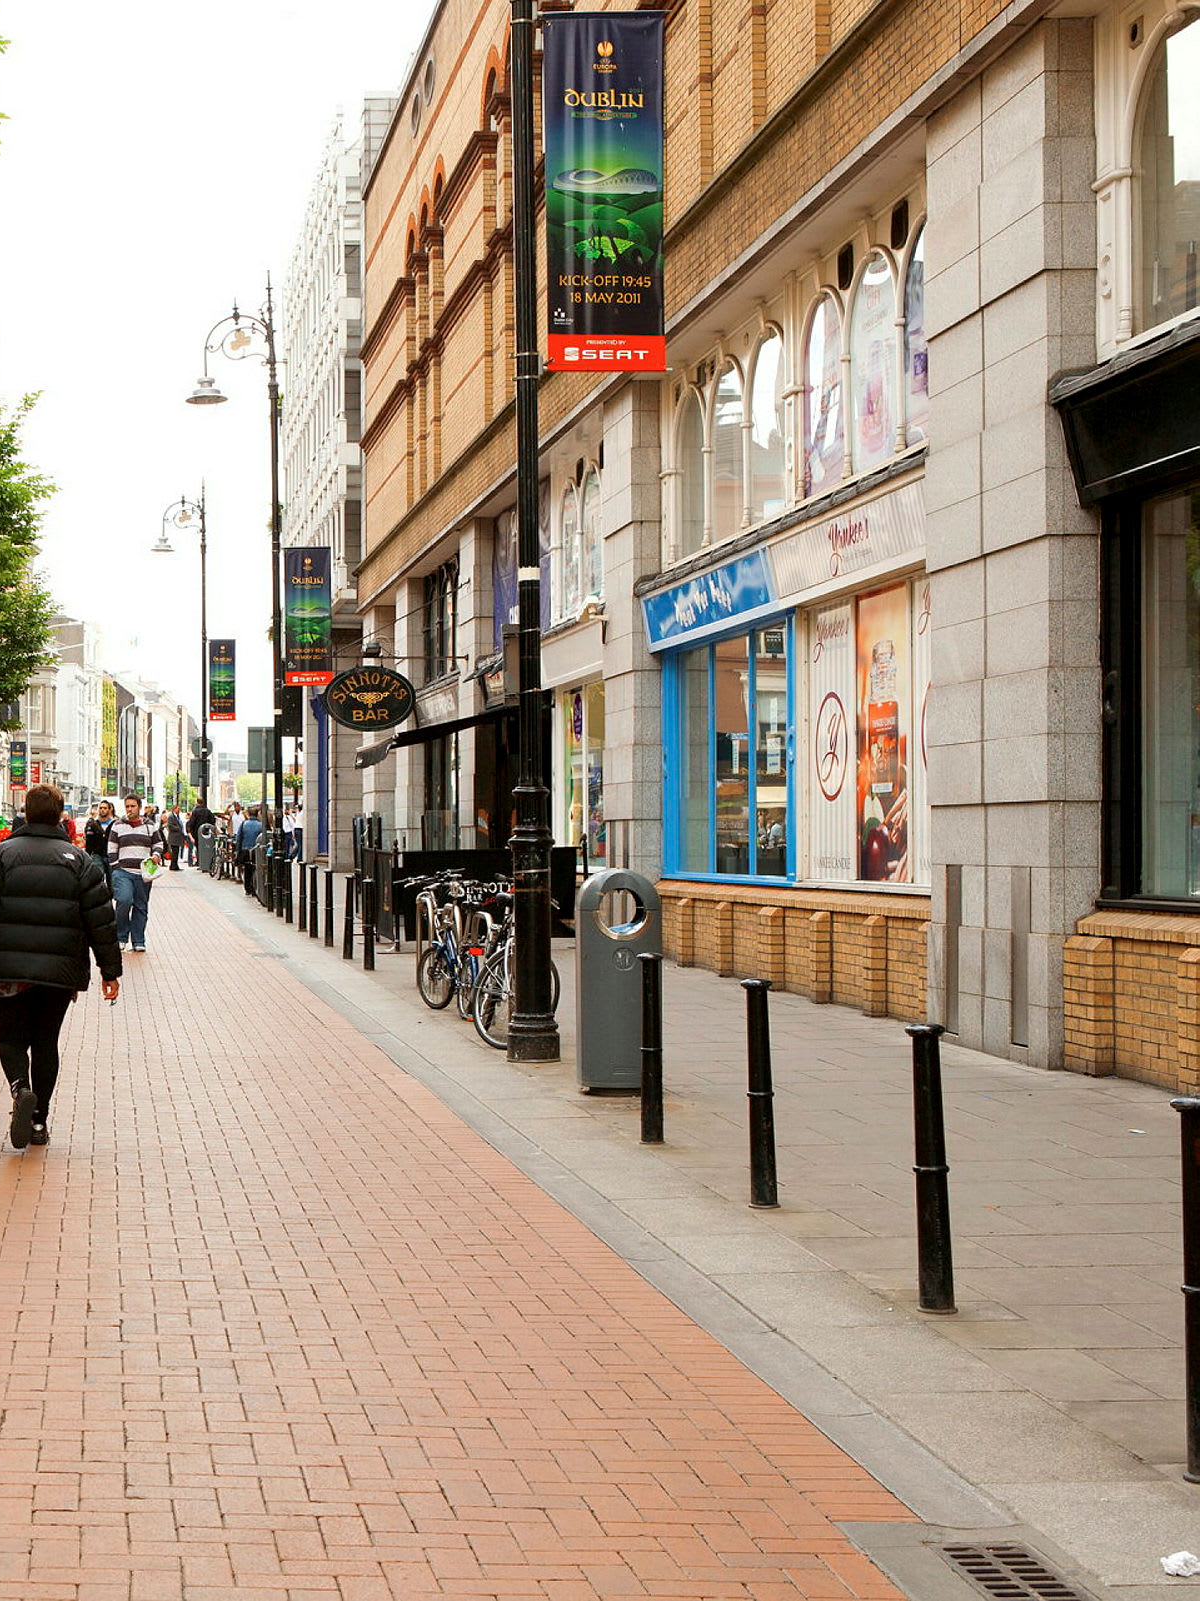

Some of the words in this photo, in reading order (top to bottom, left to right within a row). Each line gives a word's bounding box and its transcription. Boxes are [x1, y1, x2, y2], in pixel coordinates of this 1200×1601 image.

[564, 88, 644, 109] DUBLIN
[559, 274, 620, 287] KICK-OFF
[622, 275, 652, 289] 19:45
[570, 292, 582, 303] 18
[585, 292, 614, 303] MAY
[616, 293, 641, 304] 2011
[581, 349, 649, 360] SEAT
[332, 671, 407, 704] SINNOTTS
[352, 709, 390, 721] BAR
